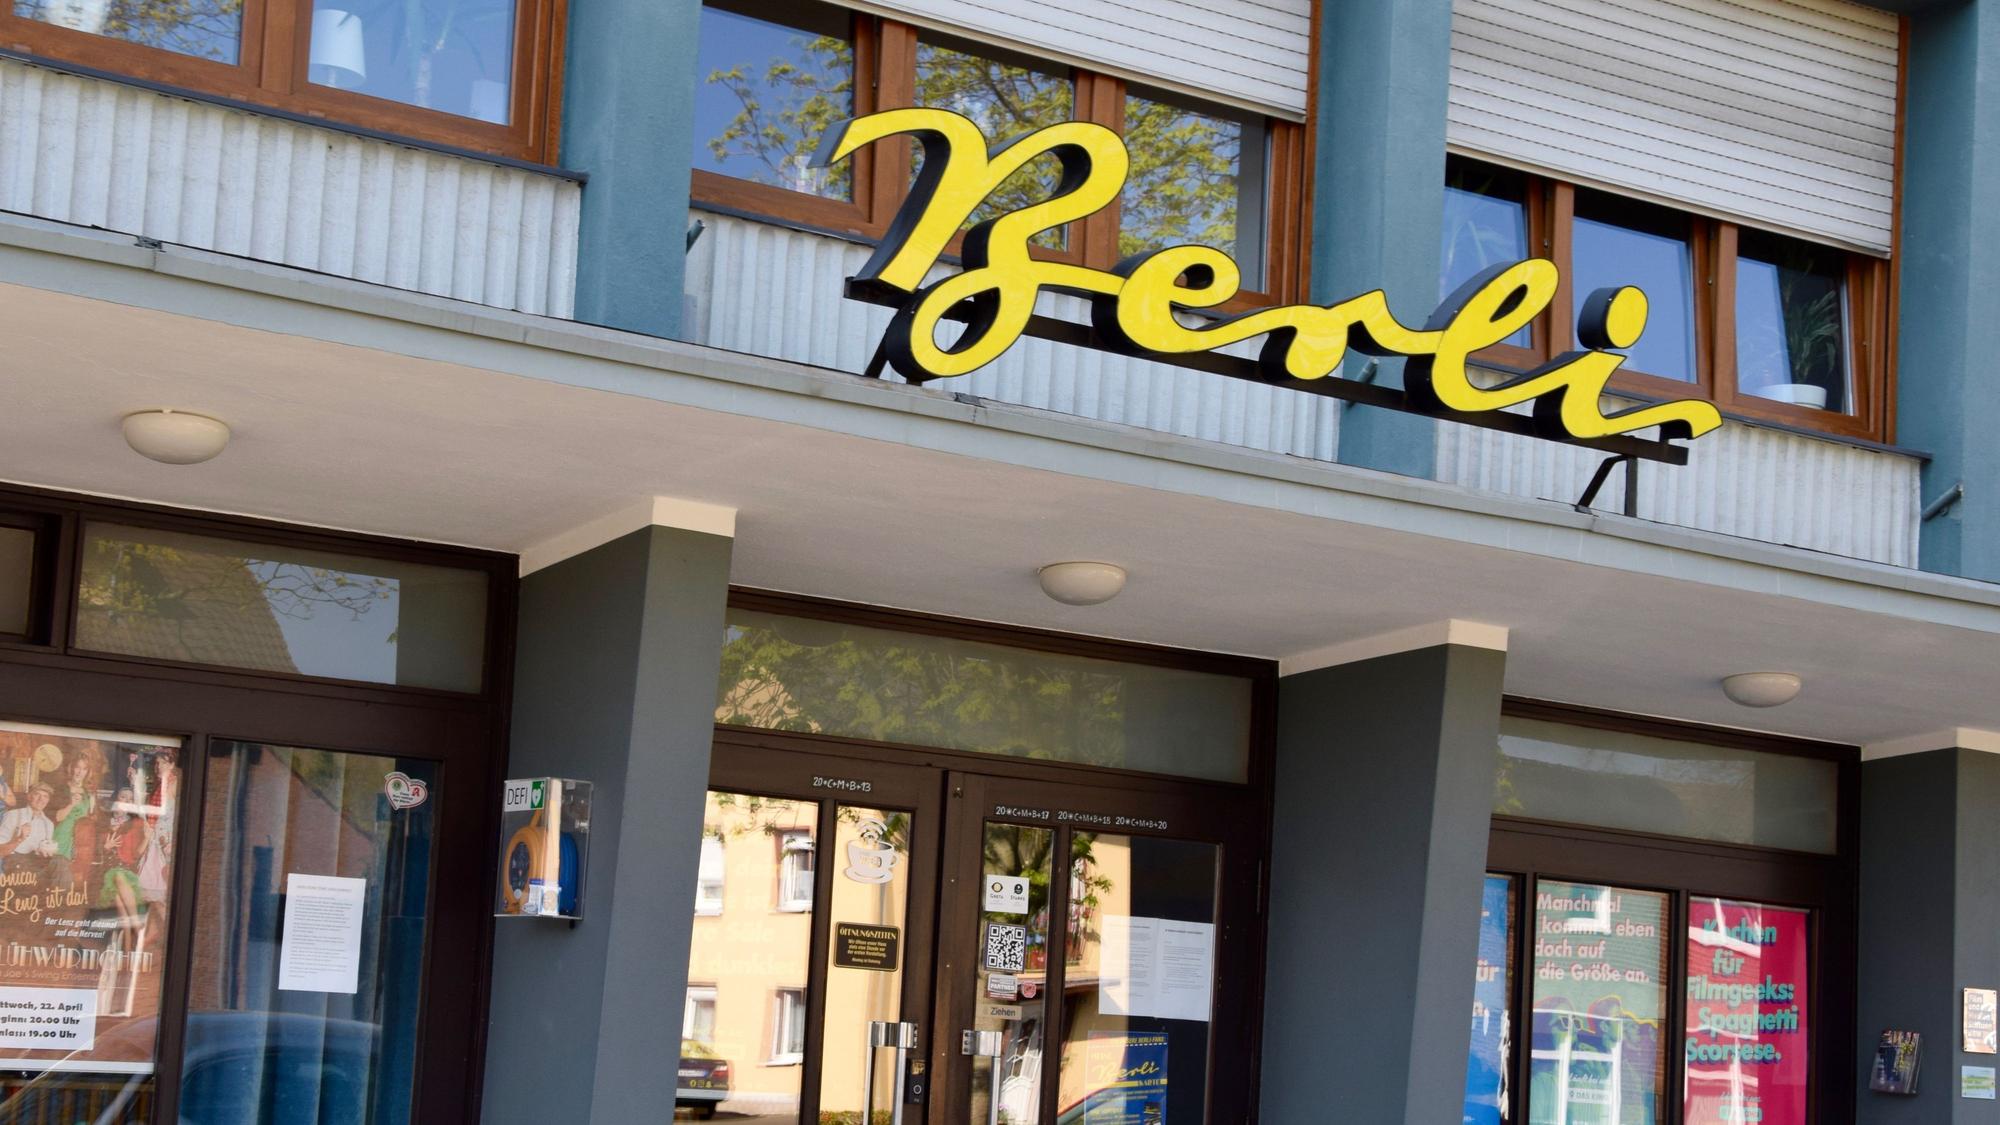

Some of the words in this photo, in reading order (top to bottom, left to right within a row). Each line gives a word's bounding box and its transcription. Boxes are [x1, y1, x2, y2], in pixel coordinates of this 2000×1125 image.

[828, 107, 1723, 440] Berli
[507, 787, 528, 805] DEFI
[0, 888, 43, 923] Lenz
[46, 886, 66, 908] ist
[1616, 918, 1655, 937] eben
[1535, 939, 1572, 957] doch
[1578, 940, 1606, 959] auf
[1712, 948, 1745, 975] für
[1539, 960, 1564, 980] die
[1570, 962, 1621, 982] Größe
[1625, 969, 1650, 984] an.
[1687, 974, 1795, 1009] Filmgeeks:
[57, 1003, 83, 1012] April
[991, 1007, 1016, 1017] Ziehen
[0, 1015, 27, 1024] ginn:
[30, 1016, 60, 1024] 20.00
[63, 1016, 80, 1025] Uhr
[1699, 1004, 1798, 1040] Spaghetti
[29, 1030, 56, 1038] 19.00
[60, 1030, 77, 1038] Uhr
